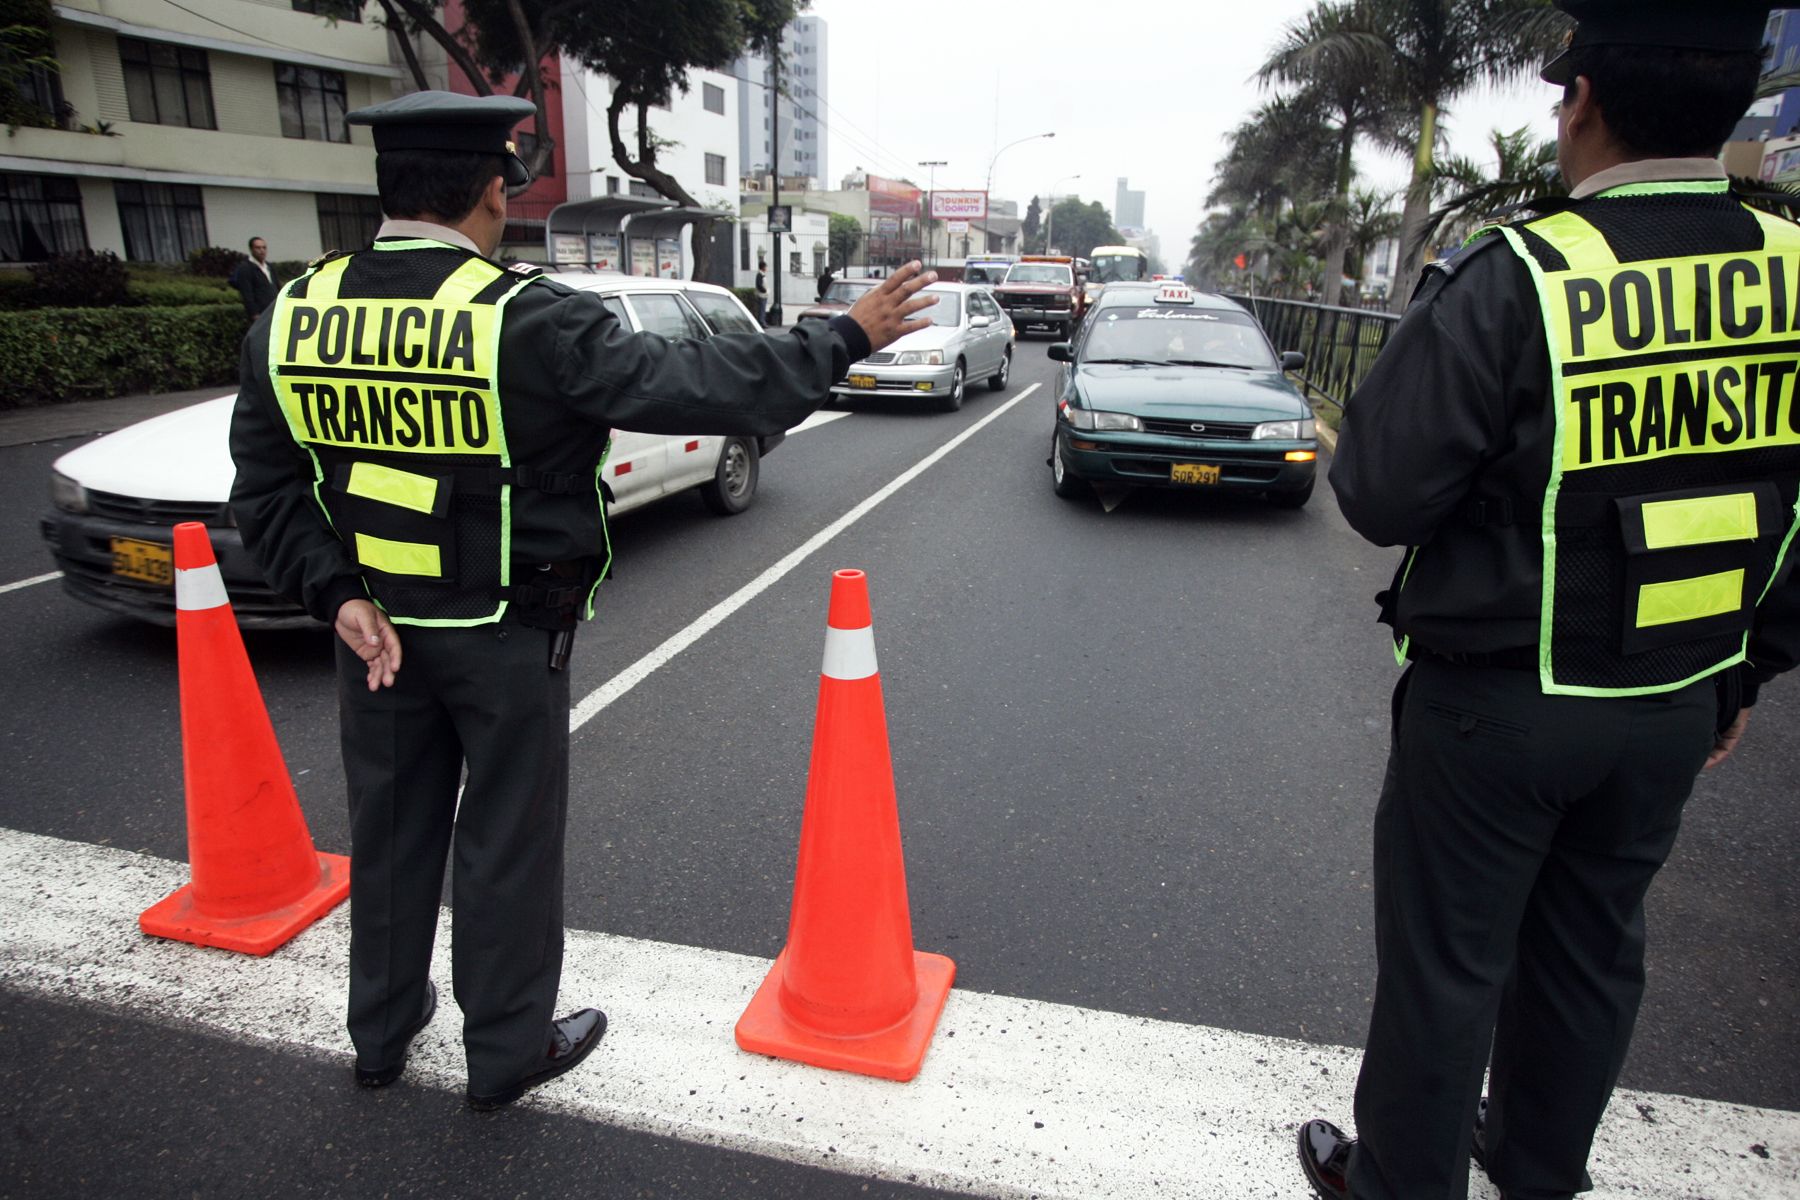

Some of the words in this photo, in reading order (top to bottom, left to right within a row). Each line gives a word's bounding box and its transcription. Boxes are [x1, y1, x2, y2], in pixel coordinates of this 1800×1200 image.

[1163, 289, 1188, 299] TAXI
[1563, 256, 1800, 357] POLICI
[286, 305, 475, 372] POLICIA
[291, 383, 489, 449] TRANSITO
